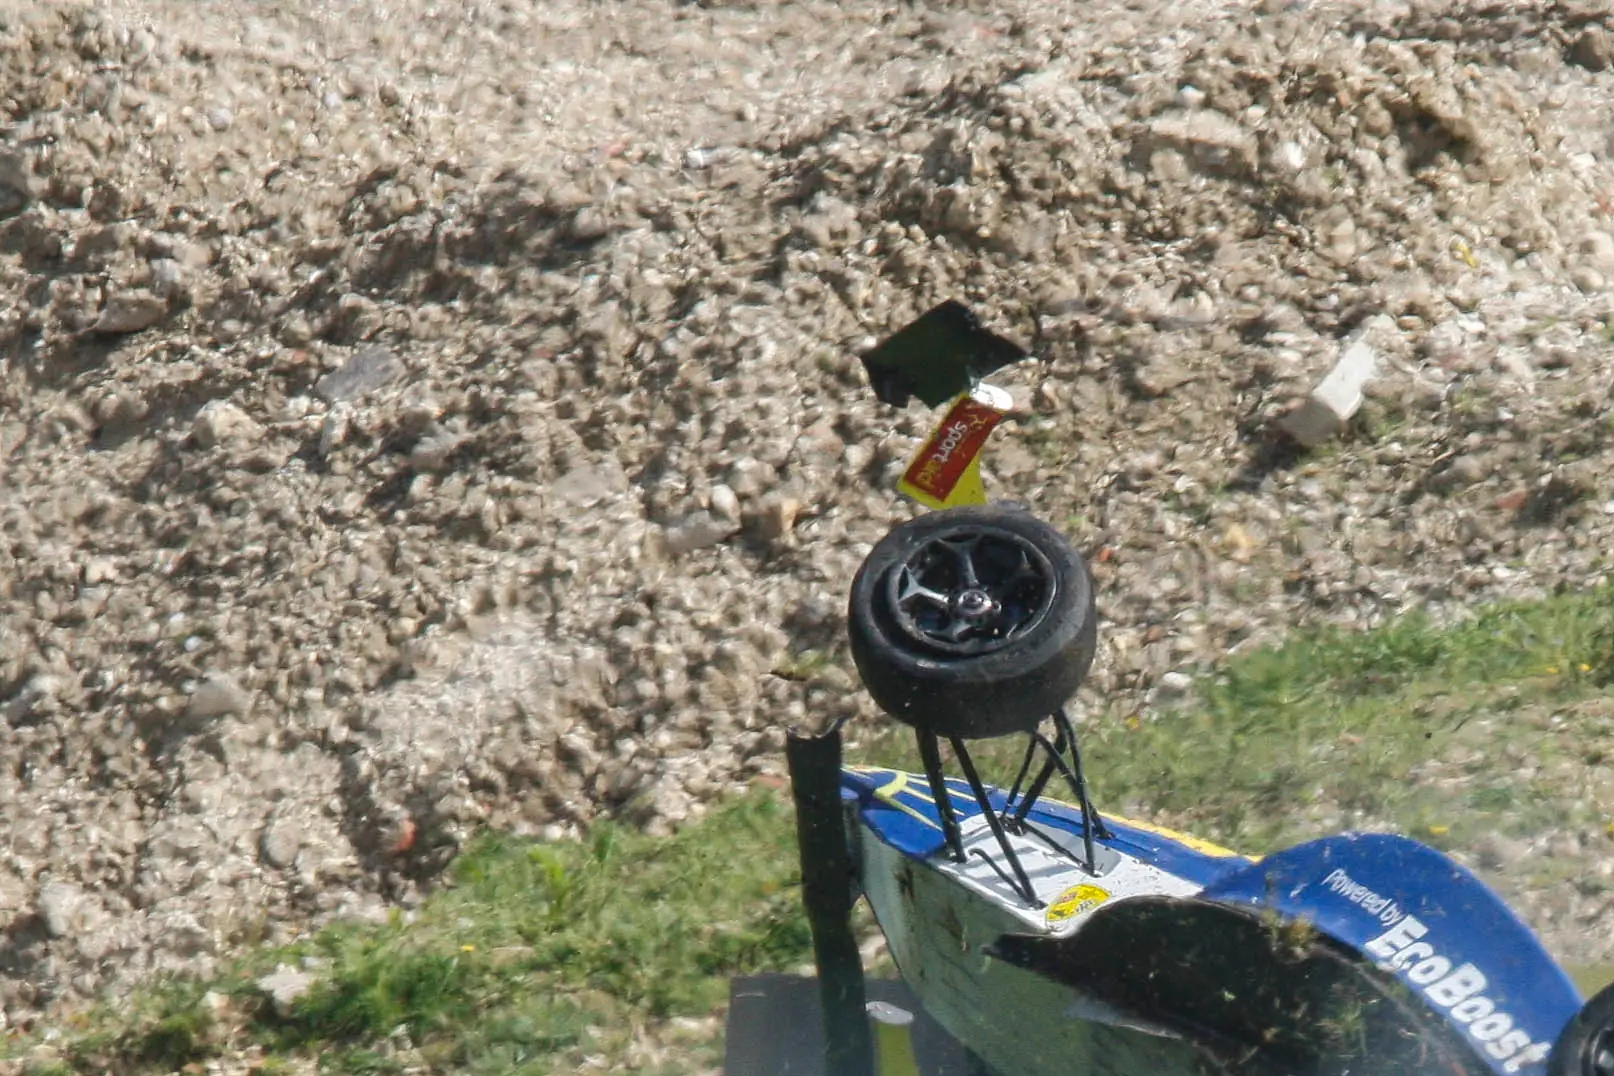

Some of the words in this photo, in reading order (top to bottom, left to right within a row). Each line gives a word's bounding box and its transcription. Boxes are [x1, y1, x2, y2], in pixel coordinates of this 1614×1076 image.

[1320, 868, 1393, 916] Powered
[1379, 902, 1405, 927] by
[1364, 914, 1552, 1073] EcoBoost
